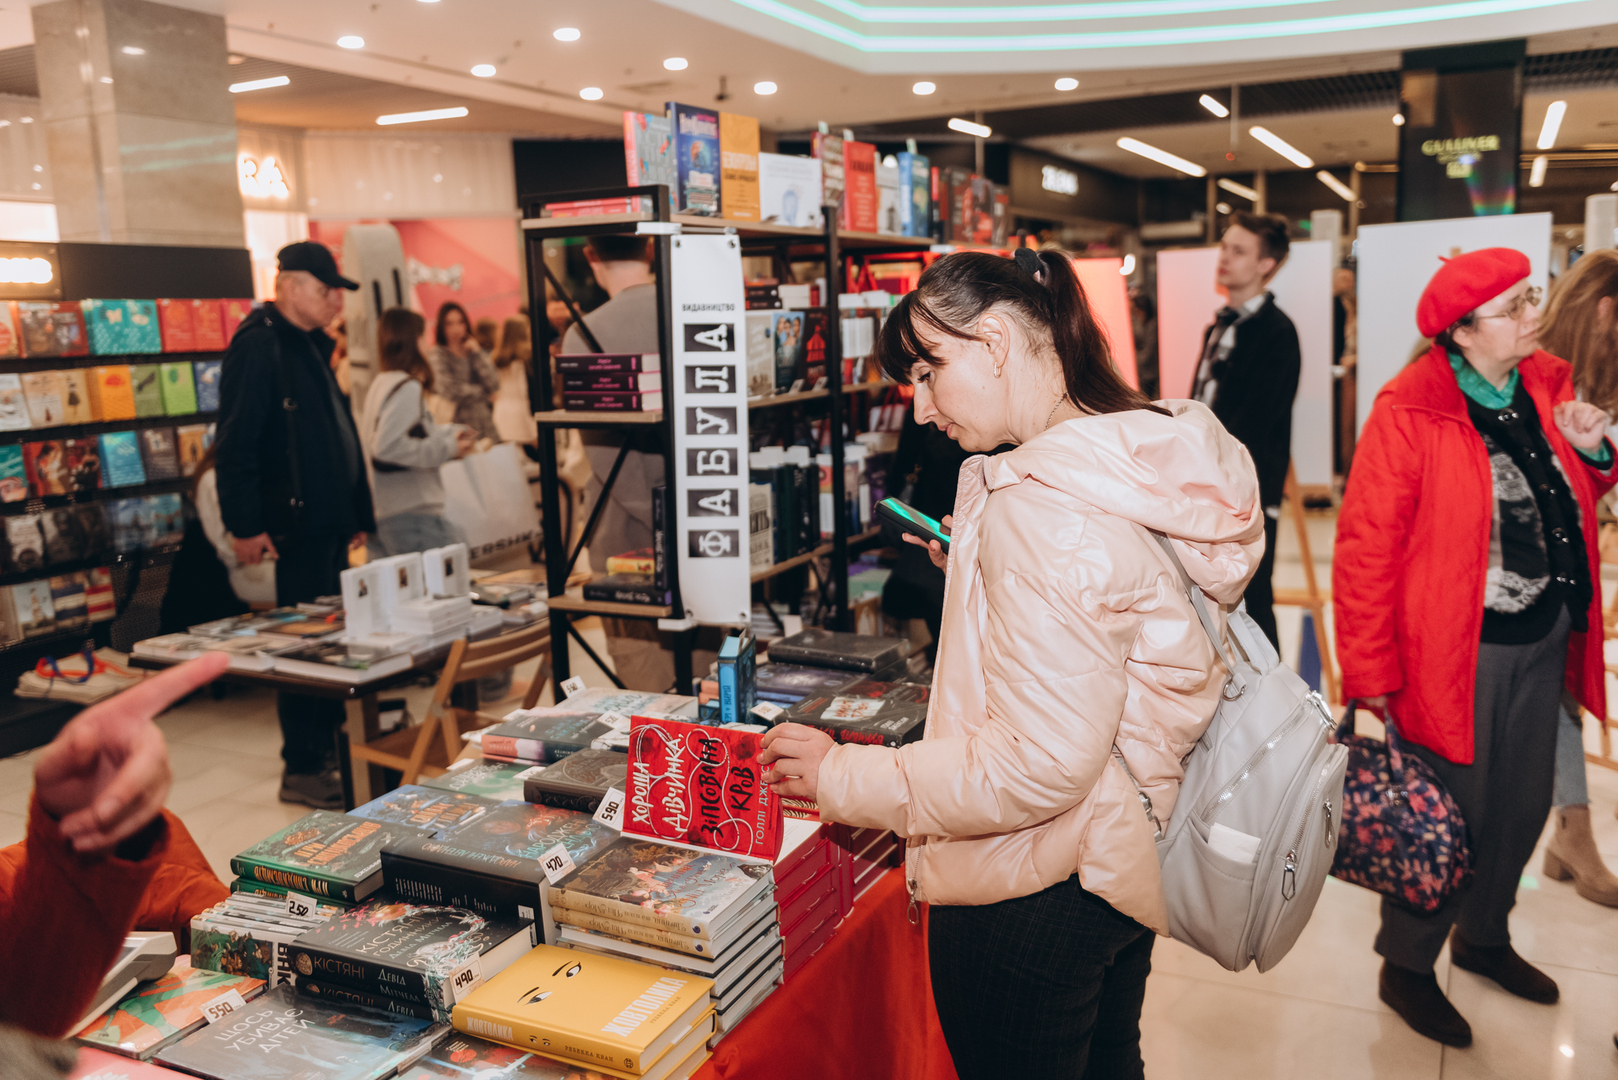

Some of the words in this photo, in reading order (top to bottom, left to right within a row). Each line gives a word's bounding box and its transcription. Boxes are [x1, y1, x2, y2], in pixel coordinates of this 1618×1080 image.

[682, 302, 735, 313] ВИДАВНИЦТВО
[691, 323, 733, 558] ФАБУЛА
[469, 529, 540, 560] ERSHK
[631, 761, 654, 825] ХОРОША
[698, 738, 724, 838] ЗІПСОВАНА
[729, 766, 755, 811] КРОВ
[758, 756, 770, 806] ДЖЕС
[601, 801, 620, 821] 590
[755, 810, 766, 845] ГОЛЛІ
[546, 855, 563, 872] 470
[289, 900, 309, 917] 250
[355, 915, 424, 954] КІСТЯНІ
[373, 917, 440, 956] ГОДИННИКИ
[313, 956, 365, 980] КІСТЯНІ
[455, 969, 474, 988] 490
[208, 1001, 234, 1019] 550
[601, 977, 688, 1037] ЖОВТОЛИКА
[214, 1010, 273, 1041] ЩОСЬ
[224, 1008, 303, 1051] УБИВАЄ
[259, 1018, 316, 1053] ДІТЕЙ
[466, 1016, 514, 1041] ЖОВТОЛИКА
[564, 1045, 595, 1058] РЕБЕККА
